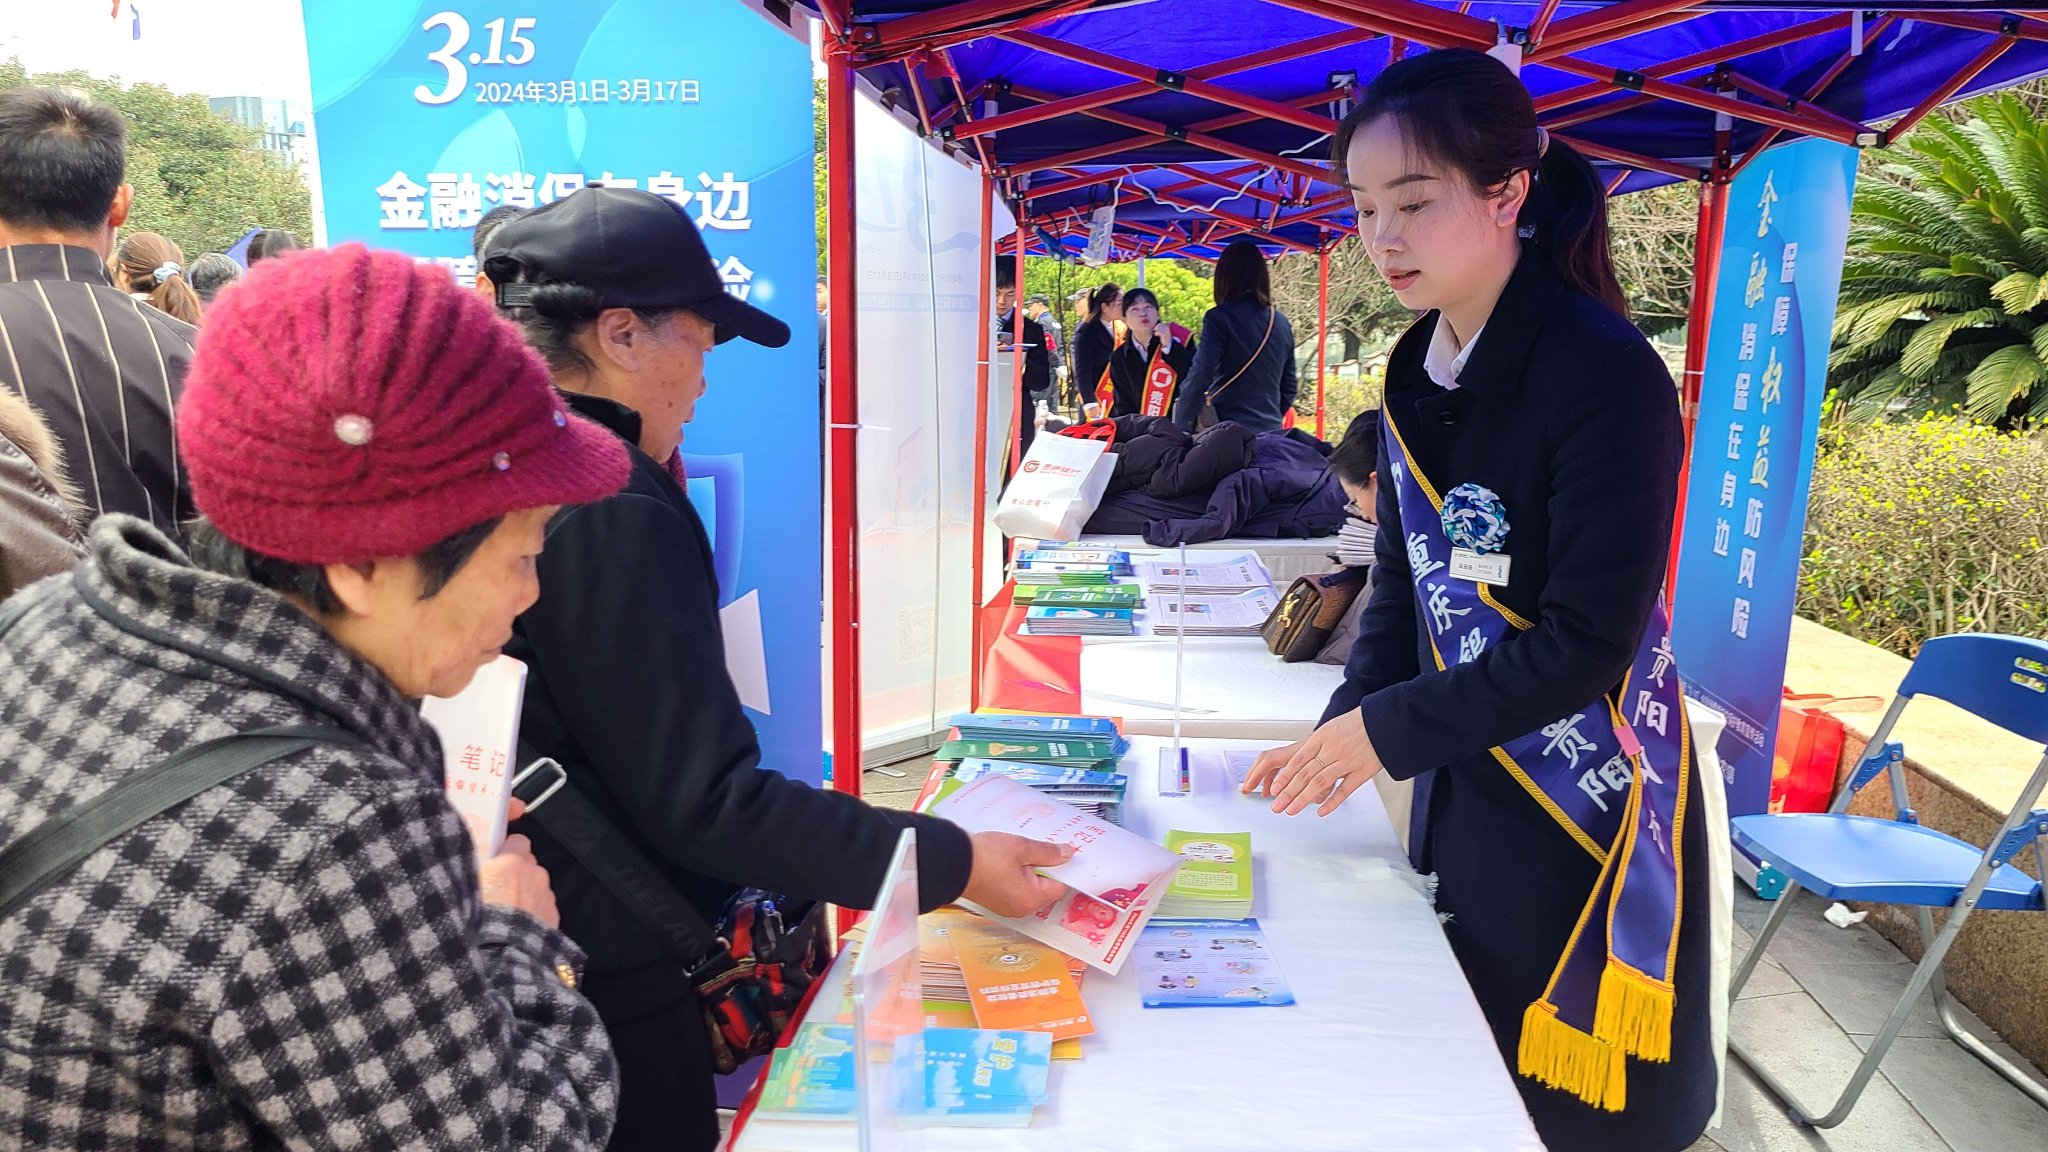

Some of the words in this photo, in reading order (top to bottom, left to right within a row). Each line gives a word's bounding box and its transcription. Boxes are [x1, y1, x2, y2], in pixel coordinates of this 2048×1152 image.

[414, 11, 537, 105] 3.15
[475, 79, 700, 103] 2024年3月1日-3月17日
[375, 170, 753, 231] 金融消保身边
[1712, 168, 1778, 557] 金融消保在身边
[1730, 242, 1799, 640] 保障权益防风险
[460, 744, 506, 778] 笔记
[1540, 713, 1634, 813] 贵阳
